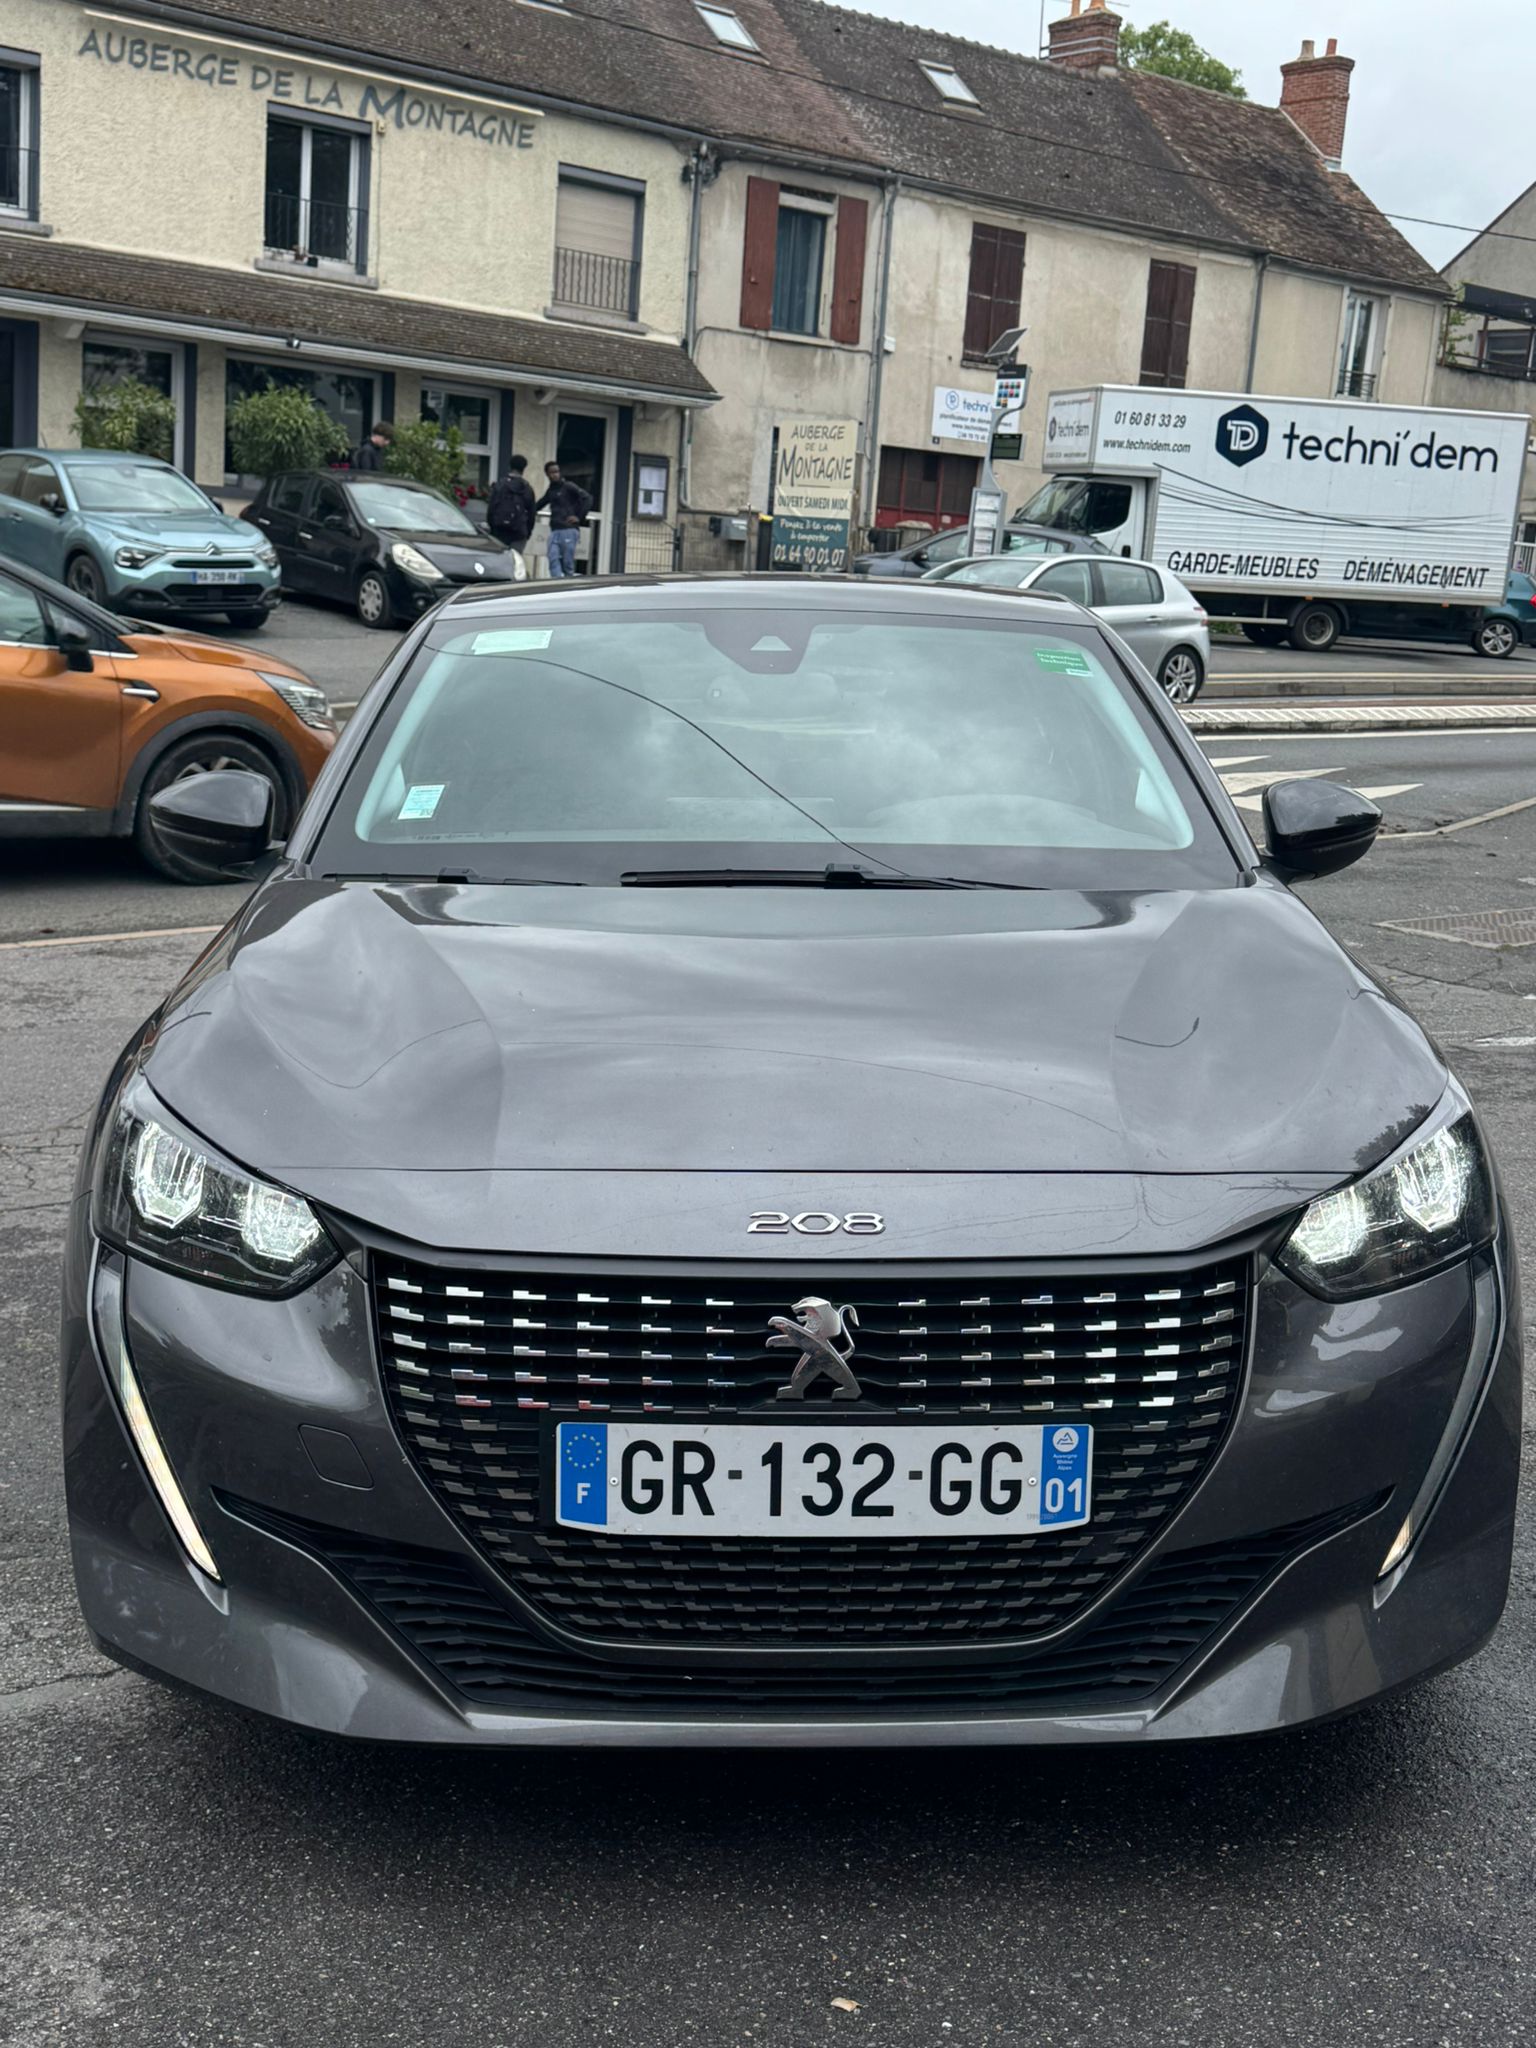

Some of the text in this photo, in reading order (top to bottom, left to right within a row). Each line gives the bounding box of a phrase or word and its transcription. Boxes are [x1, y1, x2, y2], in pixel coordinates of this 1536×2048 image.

[78, 28, 536, 149] AUBERGE DE LA MONTAGNE
[1114, 410, 1187, 429] 01 60 81 33 29
[790, 425, 846, 440] AUBERGE
[805, 442, 828, 451] DE LA
[1103, 438, 1191, 454] www.technidem.com
[778, 445, 853, 487] MONTAGNE
[777, 495, 804, 508] OUVERT
[804, 496, 830, 510] SAMEDI
[797, 532, 830, 543] emporter
[812, 520, 822, 530] la
[822, 522, 843, 532] vente
[774, 543, 846, 566] 01 64 90 01 07
[1167, 550, 1490, 588] GARDE-MEUBLES DÉMÉNAGEMENT
[746, 1211, 887, 1235] 208
[620, 1438, 1024, 1518] GR-132-GG
[576, 1482, 591, 1505] F
[1045, 1477, 1082, 1514] 01
